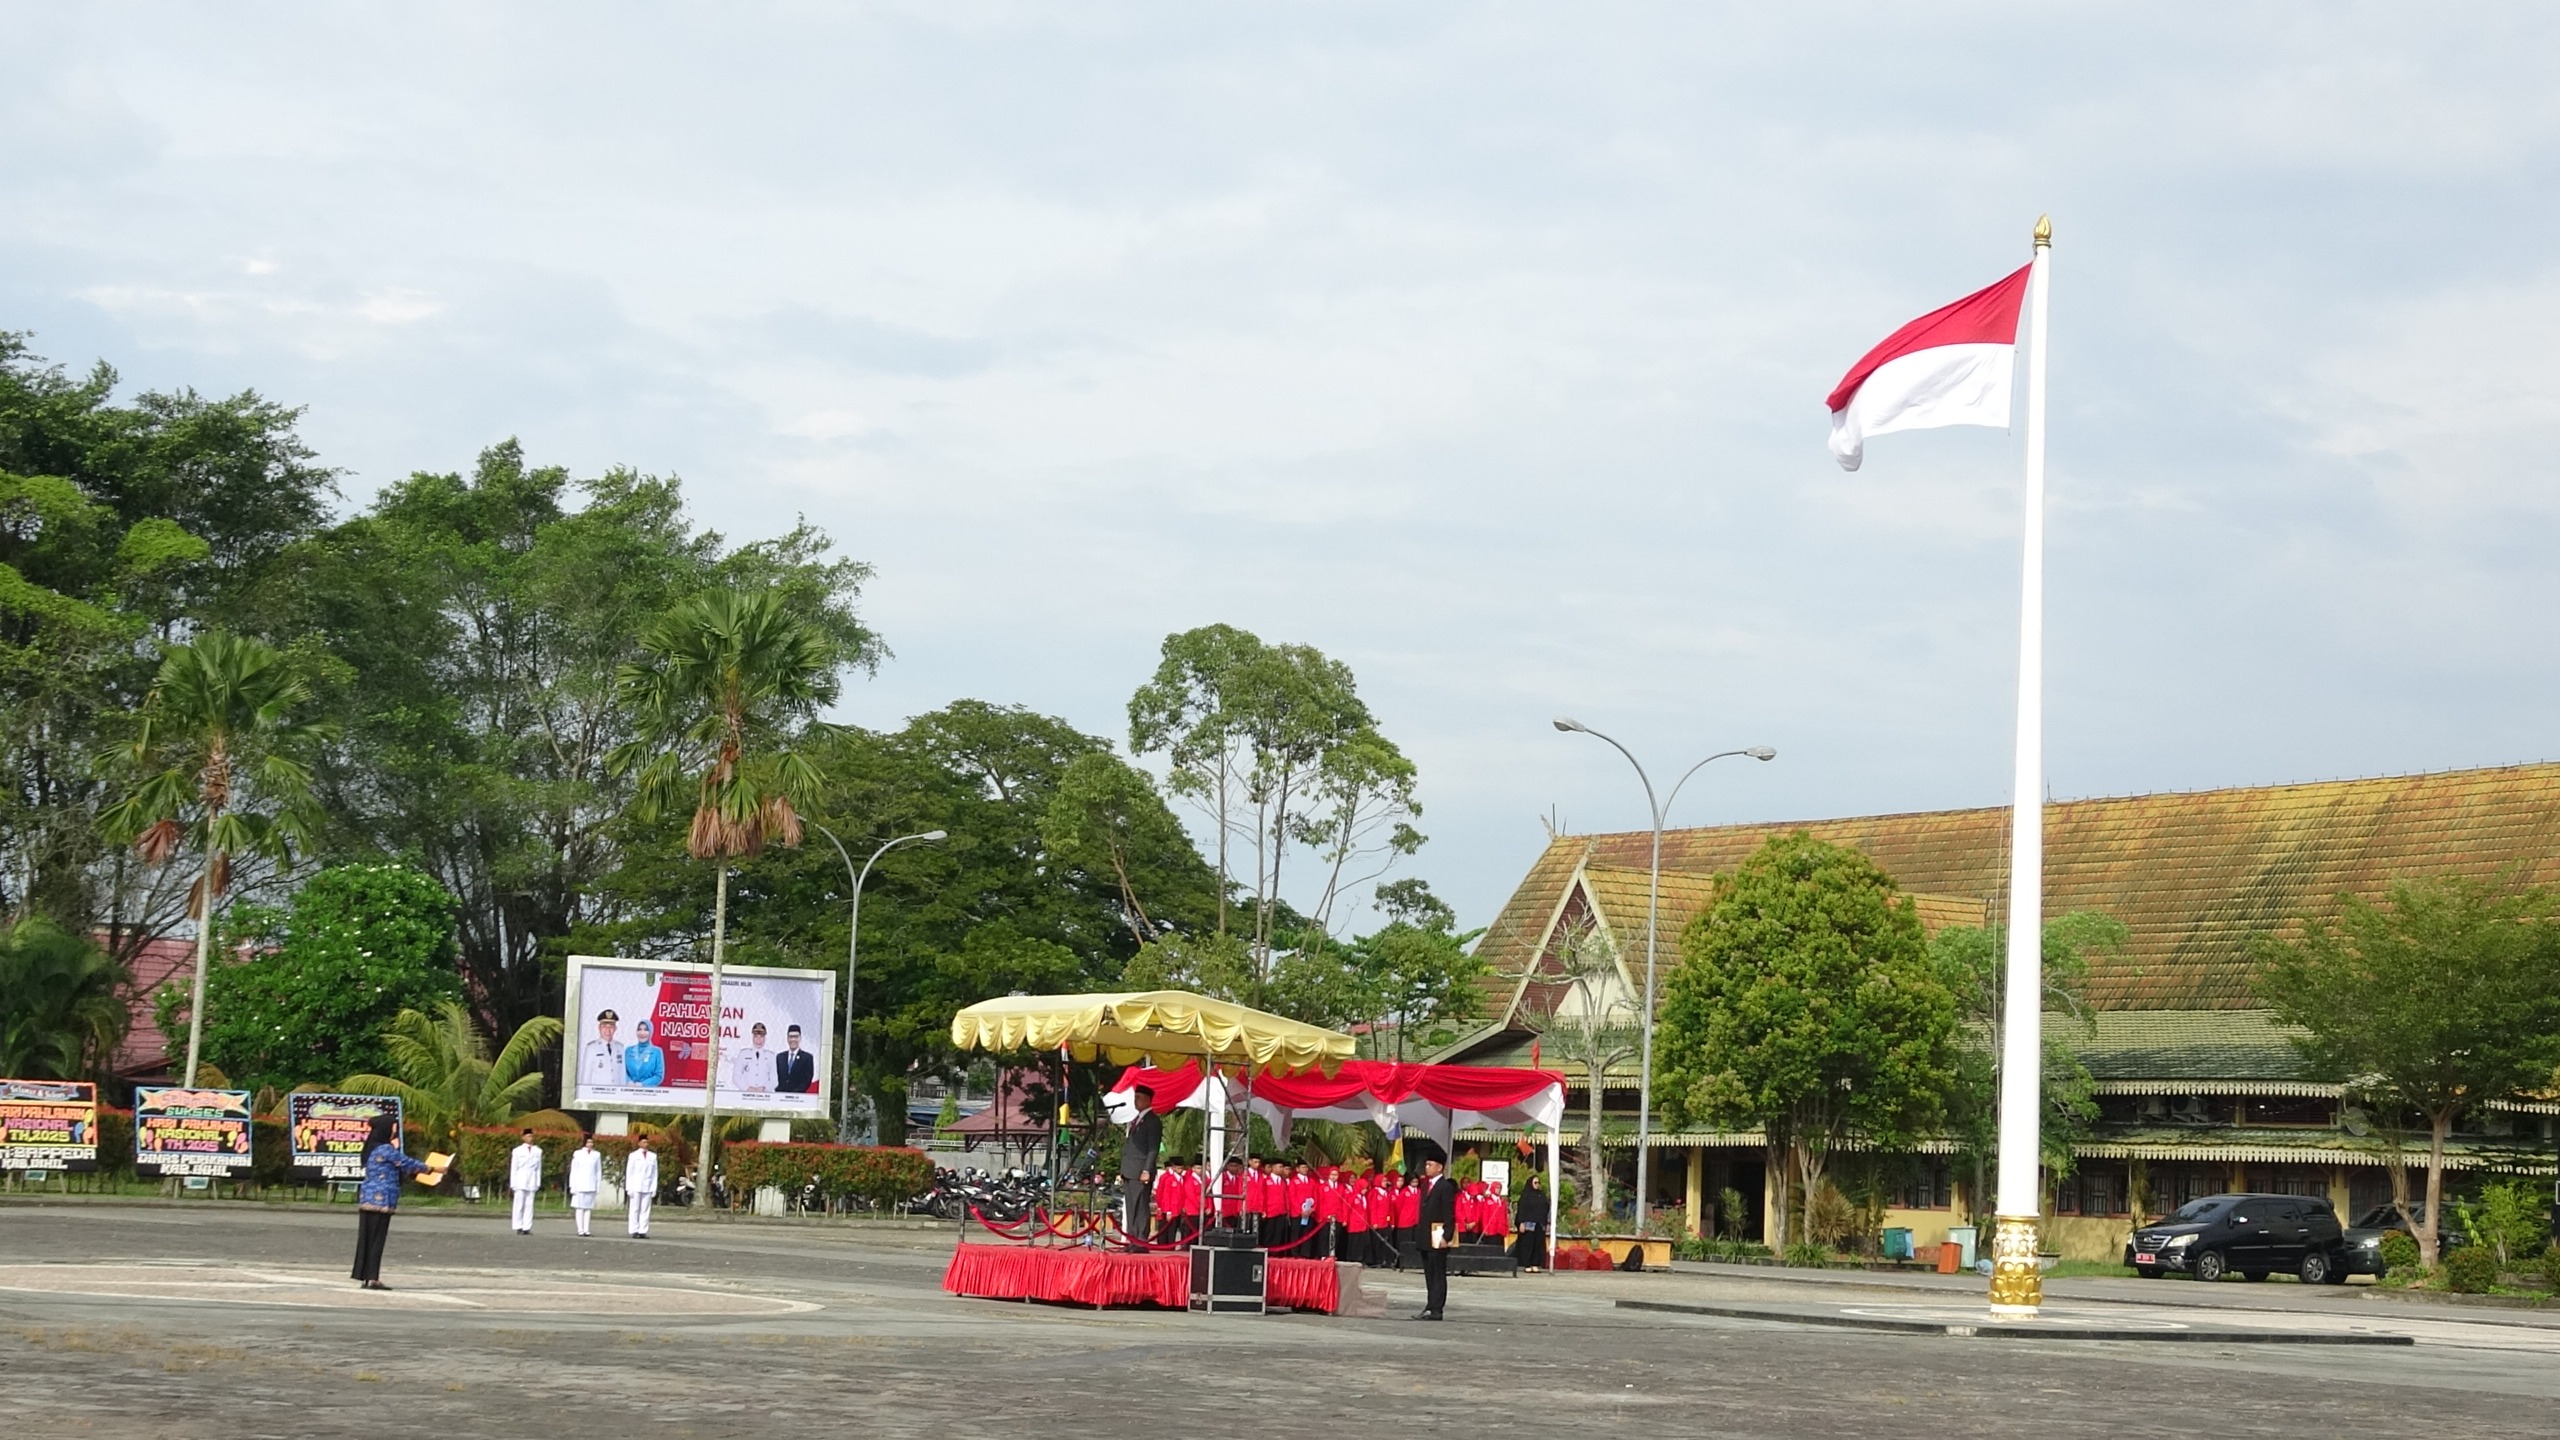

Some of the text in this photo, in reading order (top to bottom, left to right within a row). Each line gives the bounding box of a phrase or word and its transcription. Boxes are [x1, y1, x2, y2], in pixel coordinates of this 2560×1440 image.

[659, 1002, 745, 1020] PAHLAAN
[0, 1105, 86, 1120] ARI PAHLAWAN
[165, 1107, 225, 1118] SUKSES
[4, 1118, 74, 1131] NASIONAL
[146, 1118, 243, 1132] HARI PAHLAWAN
[301, 1118, 333, 1131] HARI
[155, 1128, 224, 1141] NASIONAL
[316, 1130, 370, 1142] NASION
[136, 1153, 180, 1165] DINAS
[293, 1155, 335, 1167] DINAS
[321, 1166, 367, 1179] KAB.IN
